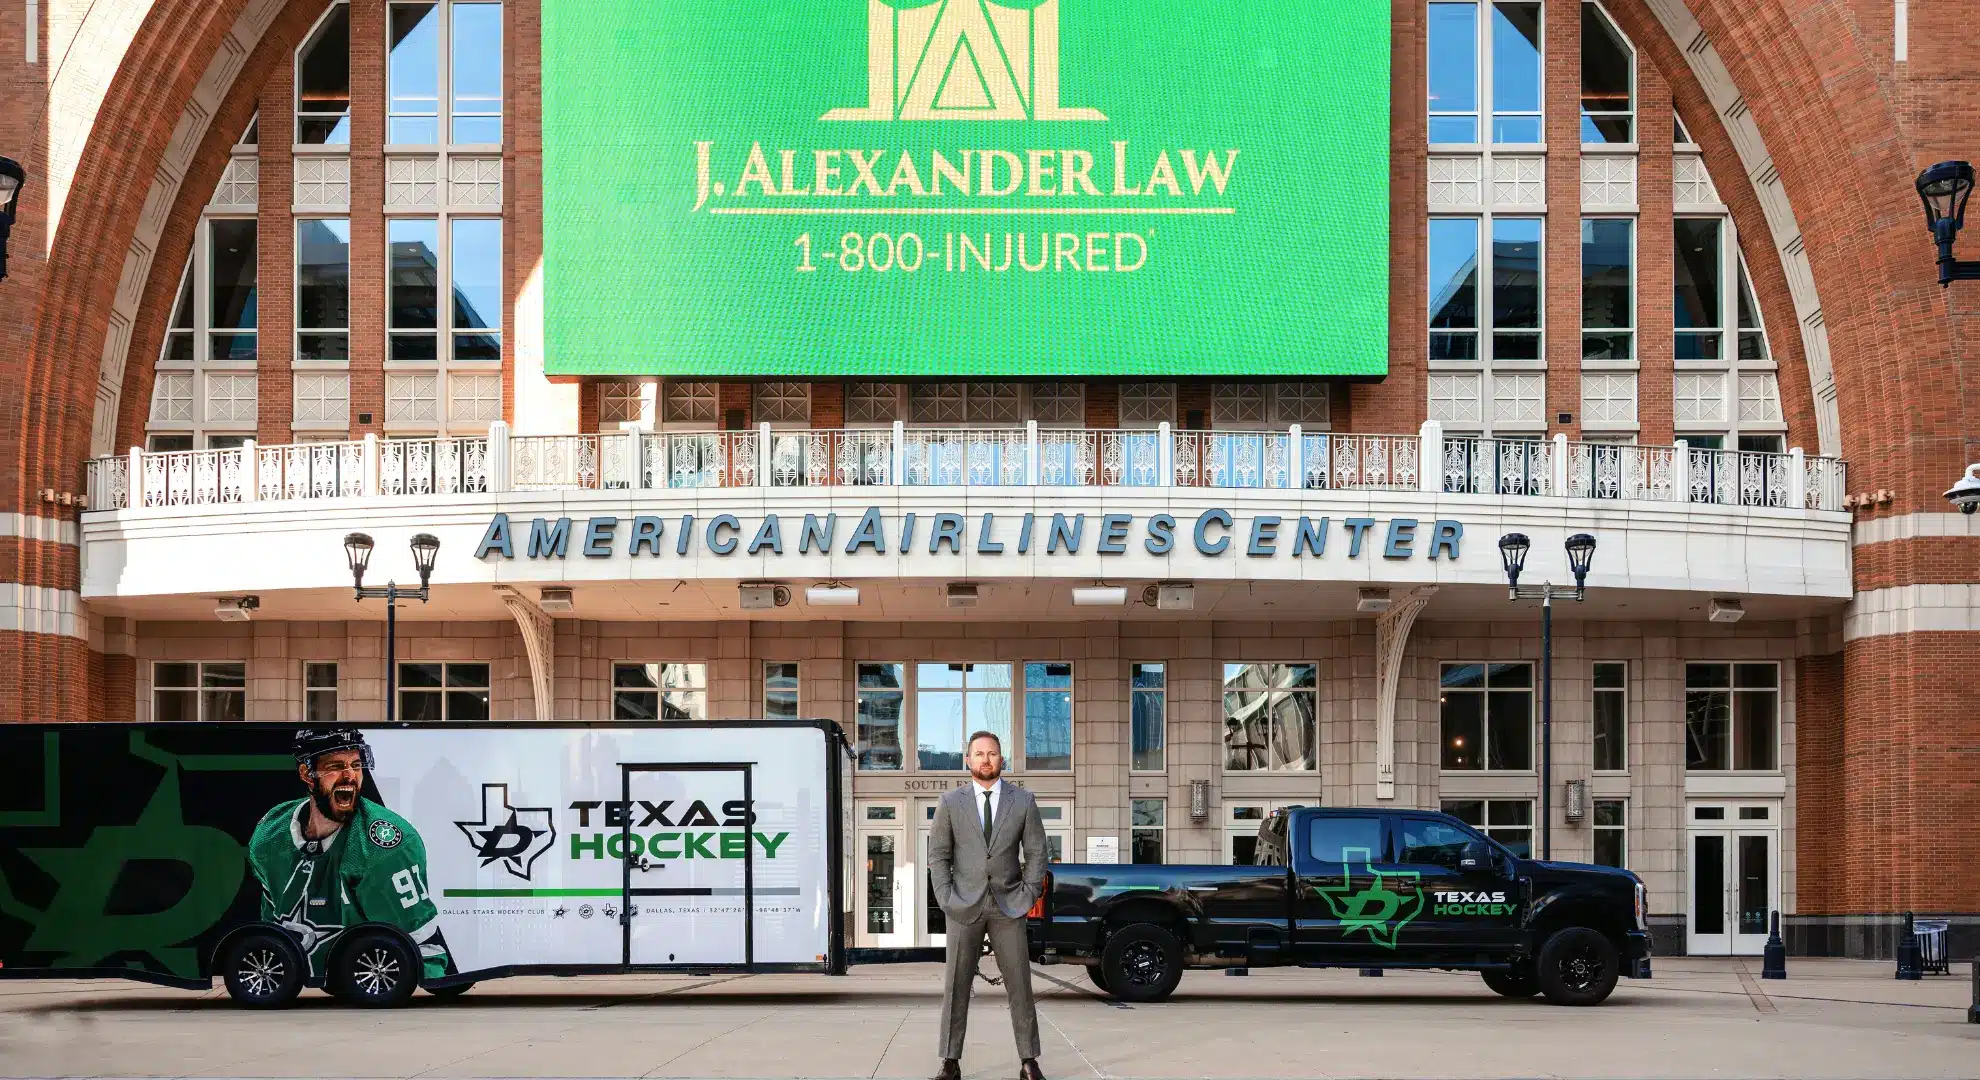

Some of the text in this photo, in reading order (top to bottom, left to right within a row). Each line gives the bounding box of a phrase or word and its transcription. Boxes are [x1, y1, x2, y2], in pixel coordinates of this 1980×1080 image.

[691, 139, 724, 213] J.
[904, 780, 948, 790] SOUTH
[568, 800, 758, 828] TEXAS
[570, 831, 791, 860] HOCKEY
[391, 864, 430, 909] 91
[1433, 891, 1507, 904] TEXAS
[1433, 903, 1518, 916] HOCKEY
